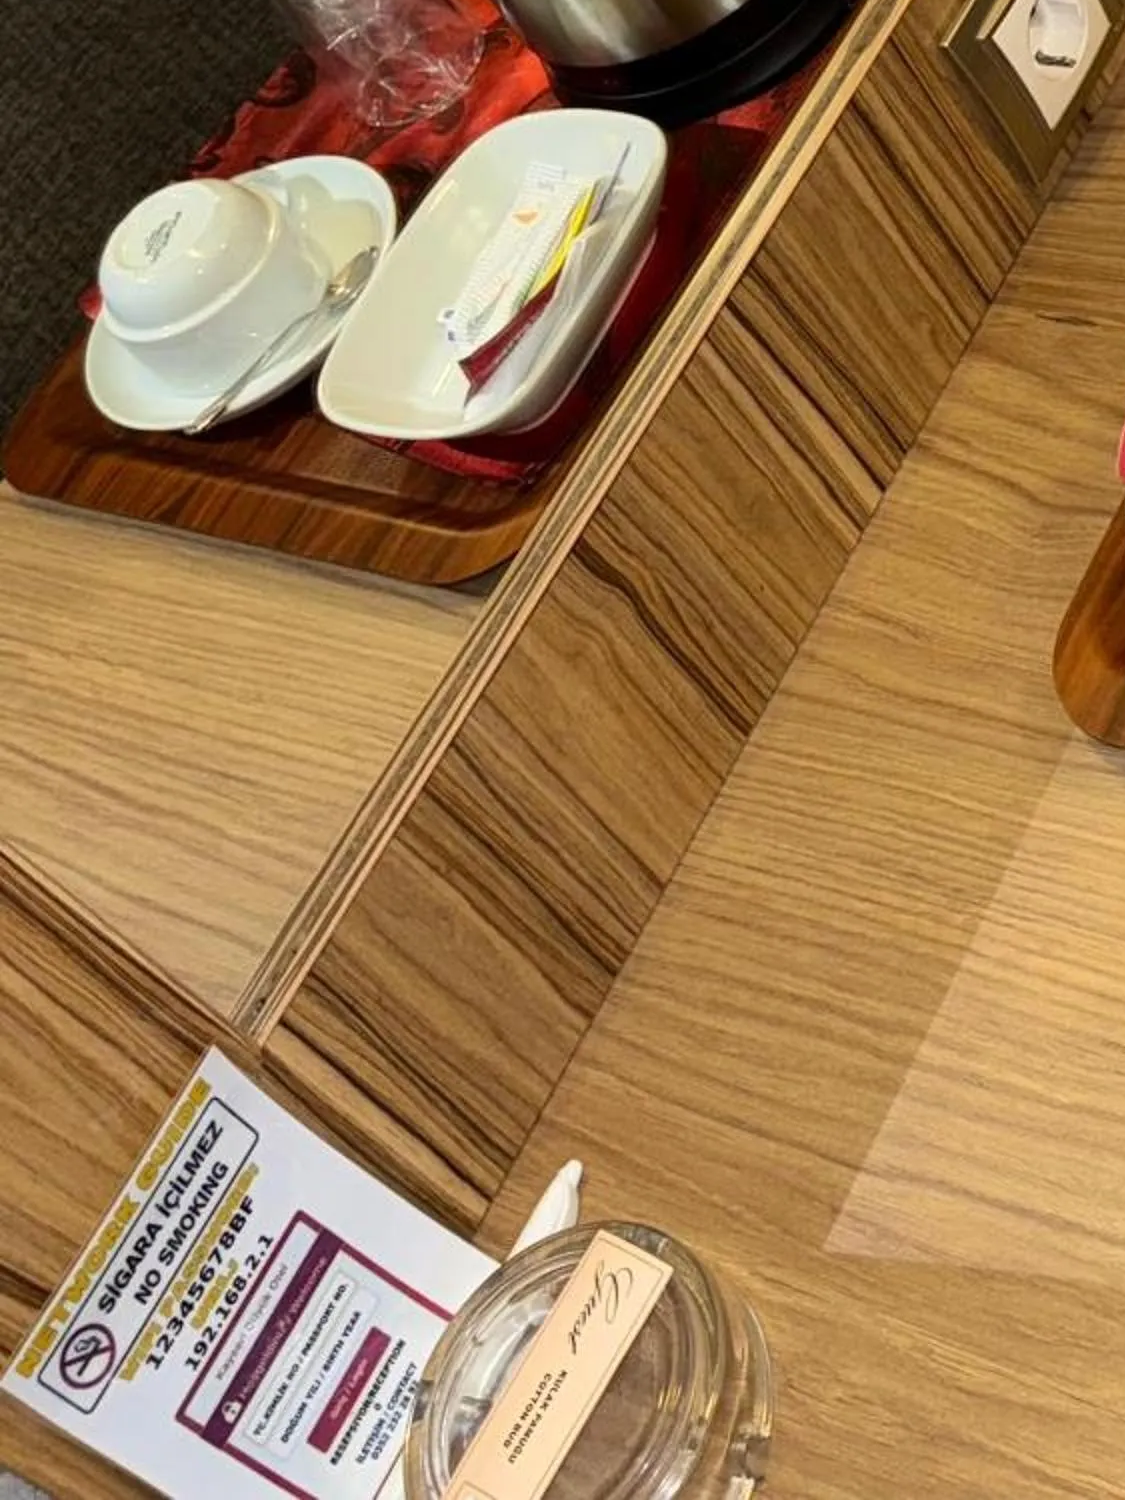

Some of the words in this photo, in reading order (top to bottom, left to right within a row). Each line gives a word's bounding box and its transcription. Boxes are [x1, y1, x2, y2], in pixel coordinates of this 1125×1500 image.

[16, 1195, 141, 1379] NETWORK
[132, 1075, 213, 1193] GUIDE
[94, 1217, 163, 1315] SİGARA
[153, 1120, 224, 1219] İÇİLMEZ
[133, 1267, 164, 1305] NO
[156, 1160, 229, 1267] SMOKING
[145, 1195, 258, 1371] 12345678BF
[184, 1232, 275, 1371] 192.168.2.1
[300, 1302, 336, 1357] PASSPORT
[564, 1259, 633, 1356] Guest
[386, 1361, 418, 1412] CONTACT
[519, 1372, 553, 1422] COTTON
